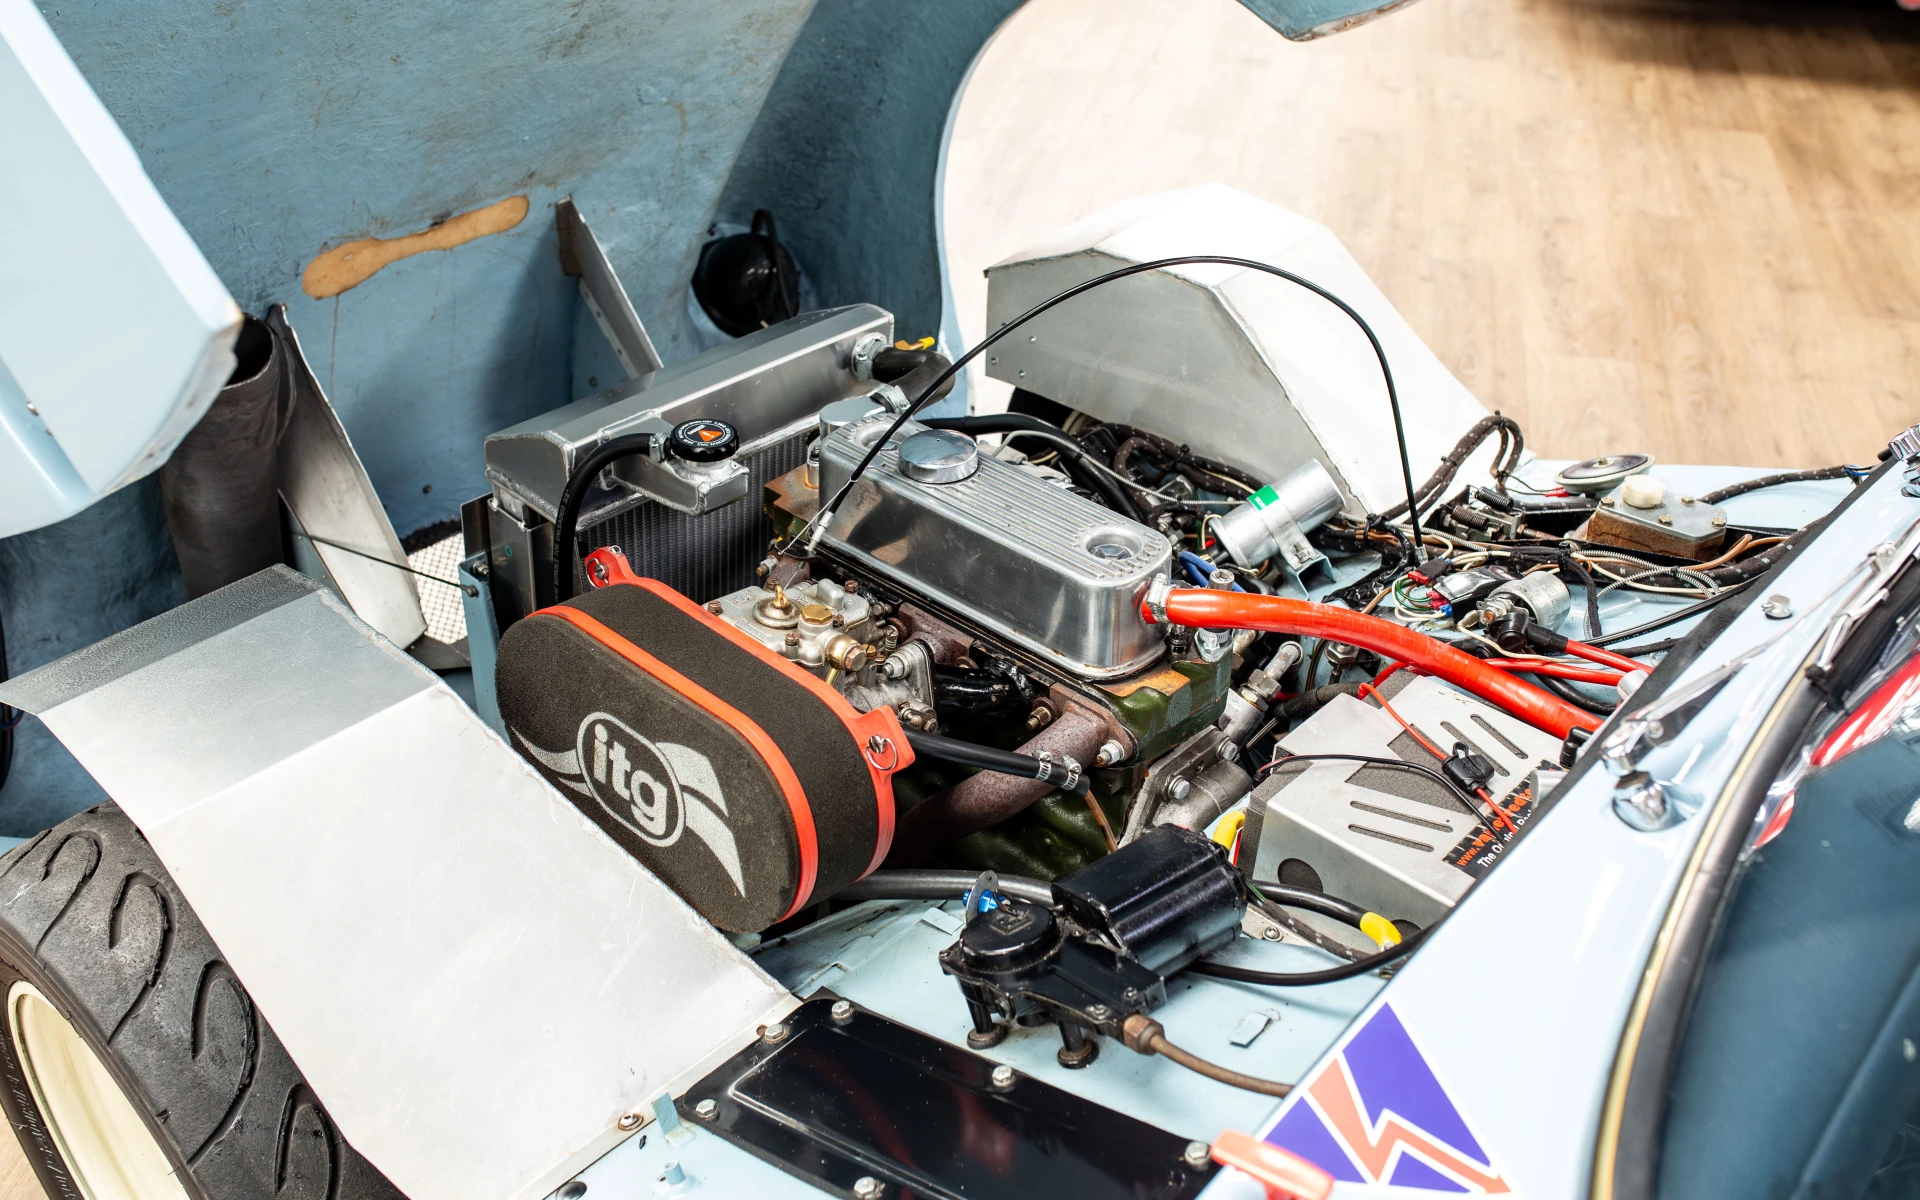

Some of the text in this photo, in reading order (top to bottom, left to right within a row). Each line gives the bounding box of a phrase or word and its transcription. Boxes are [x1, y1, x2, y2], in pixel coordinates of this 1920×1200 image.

[555, 505, 566, 541] UNLEADED
[593, 723, 668, 836] itg
[1476, 852, 1497, 867] The
